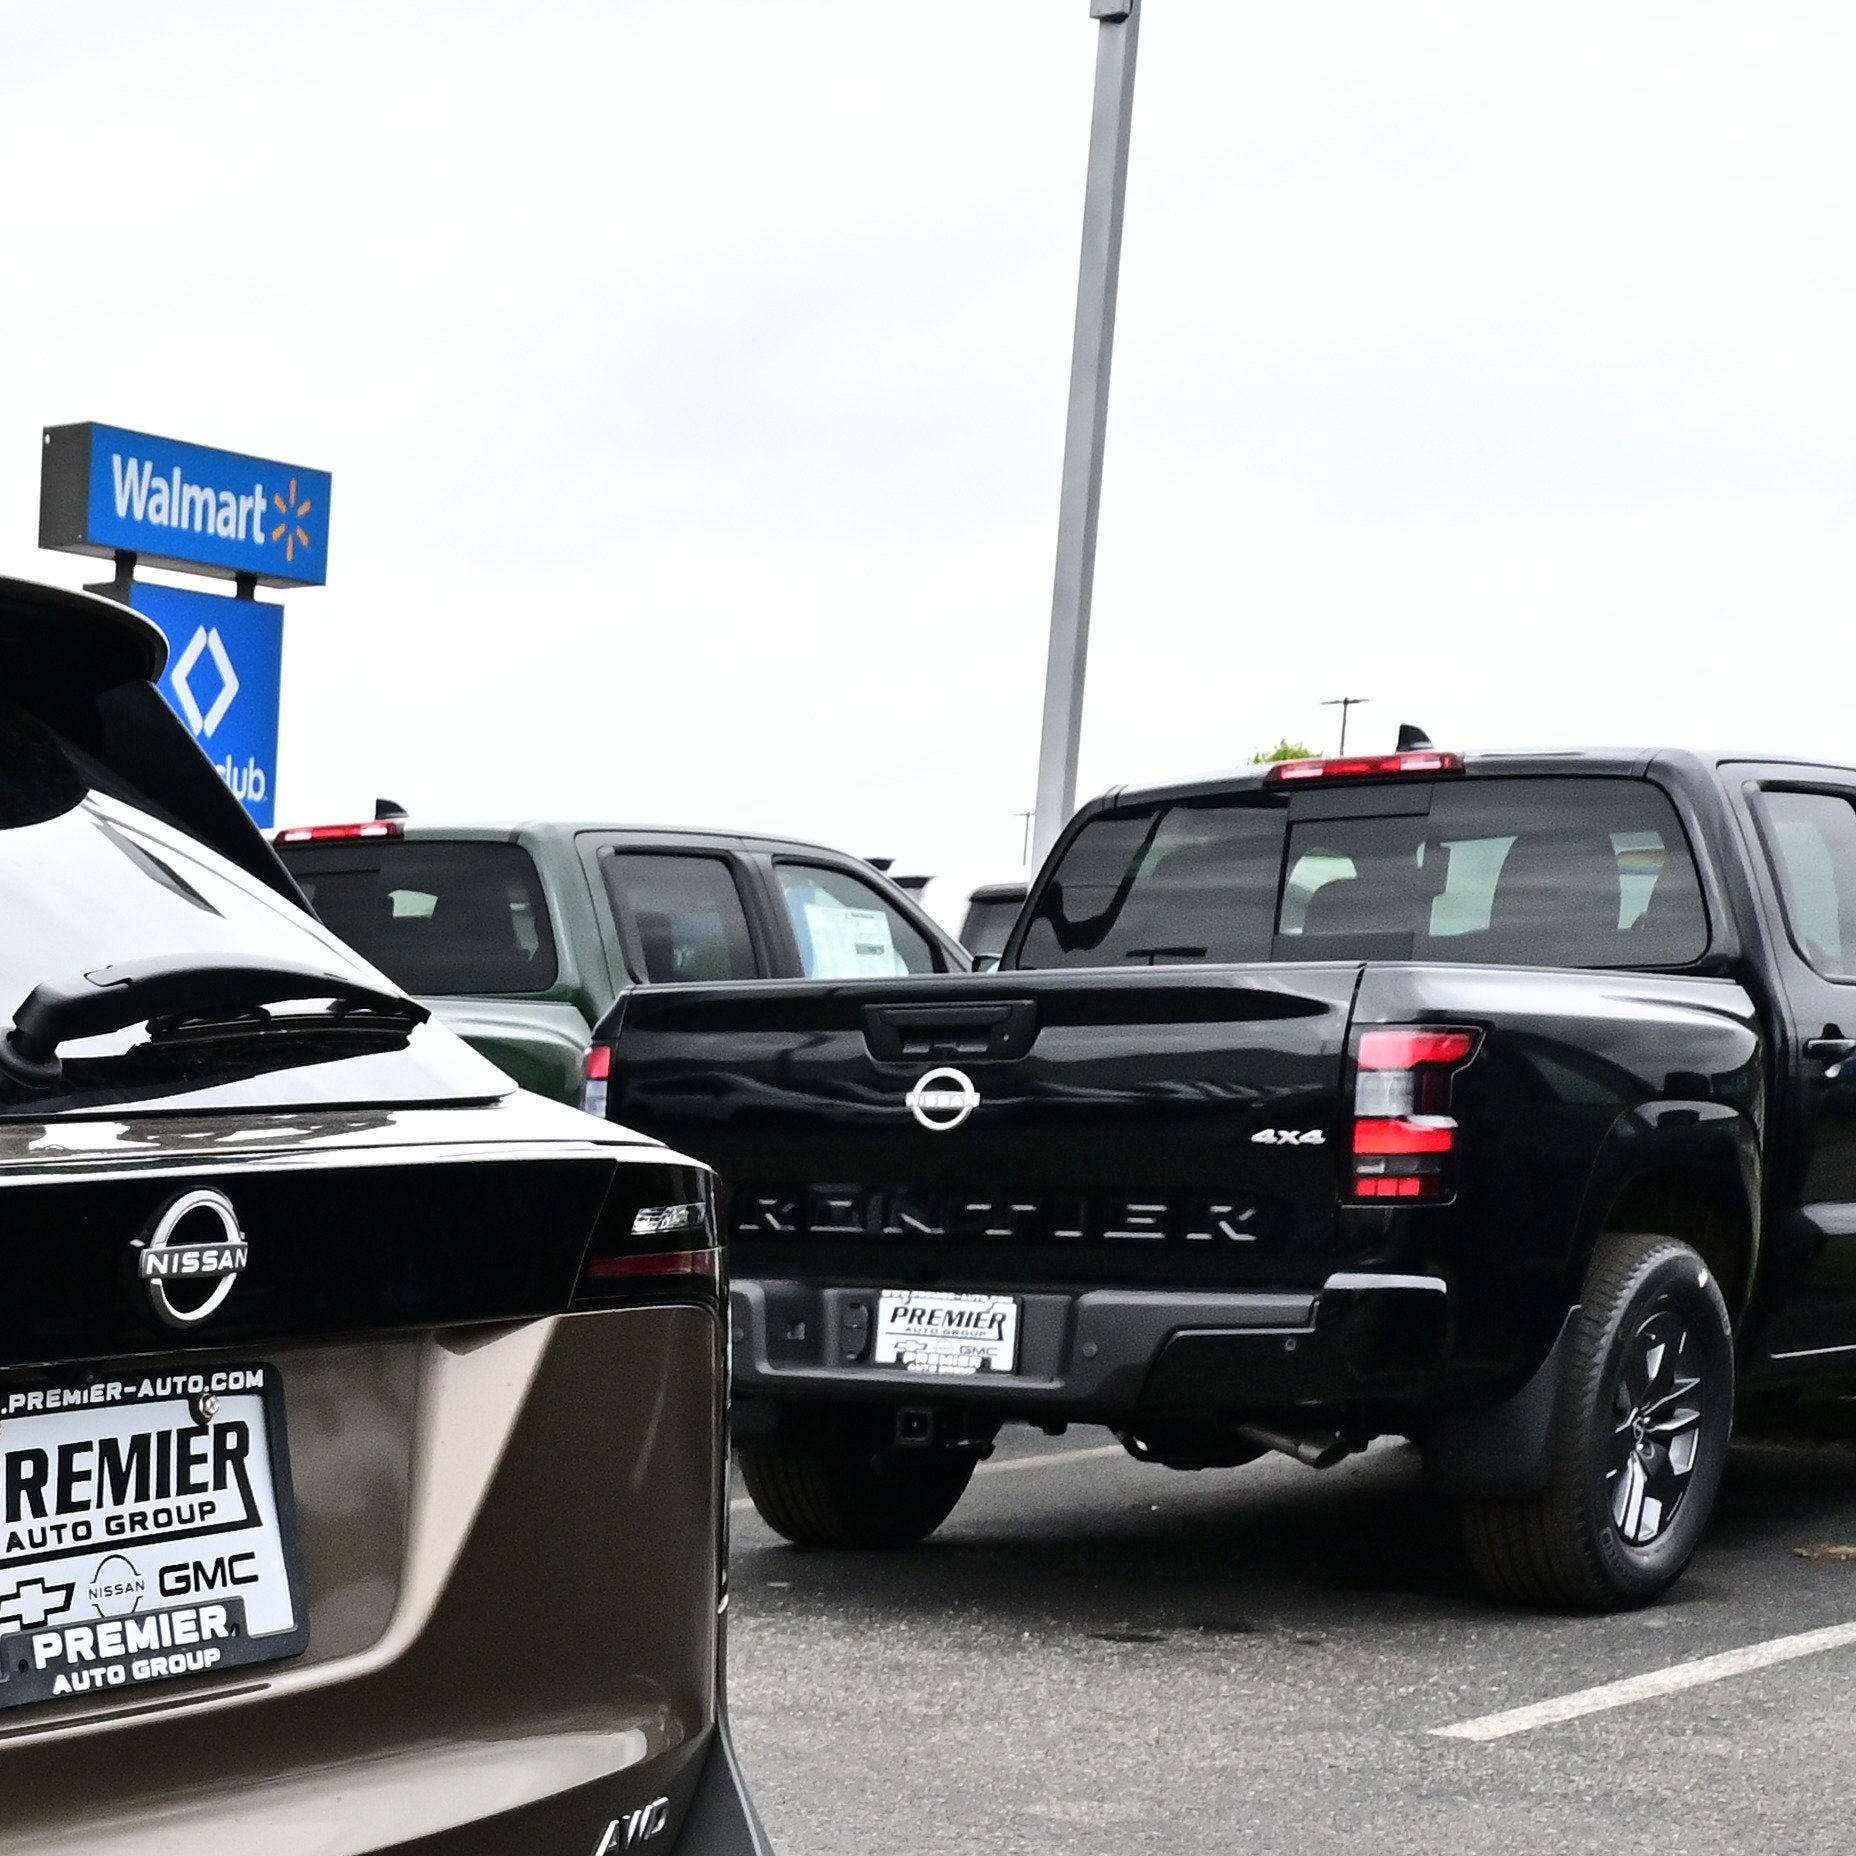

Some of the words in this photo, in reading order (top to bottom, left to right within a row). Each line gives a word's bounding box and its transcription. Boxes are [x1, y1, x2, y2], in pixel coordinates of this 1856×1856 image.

[112, 453, 266, 544] Walmart
[738, 1198, 1257, 1242] RONTIER
[146, 1247, 249, 1275] NISSAN
[890, 1306, 1007, 1340] PREMIER
[905, 1326, 938, 1335] AUTO
[943, 1329, 986, 1337] GROUP
[960, 1345, 998, 1357] GMC
[6, 1520, 92, 1553] AUTO
[105, 1500, 217, 1536] GROUP
[88, 1580, 145, 1599] NISSAN
[159, 1552, 259, 1597] GMC
[32, 1604, 229, 1670] PREMIER
[52, 1664, 126, 1695] AUTO
[132, 1648, 221, 1681] GROUP
